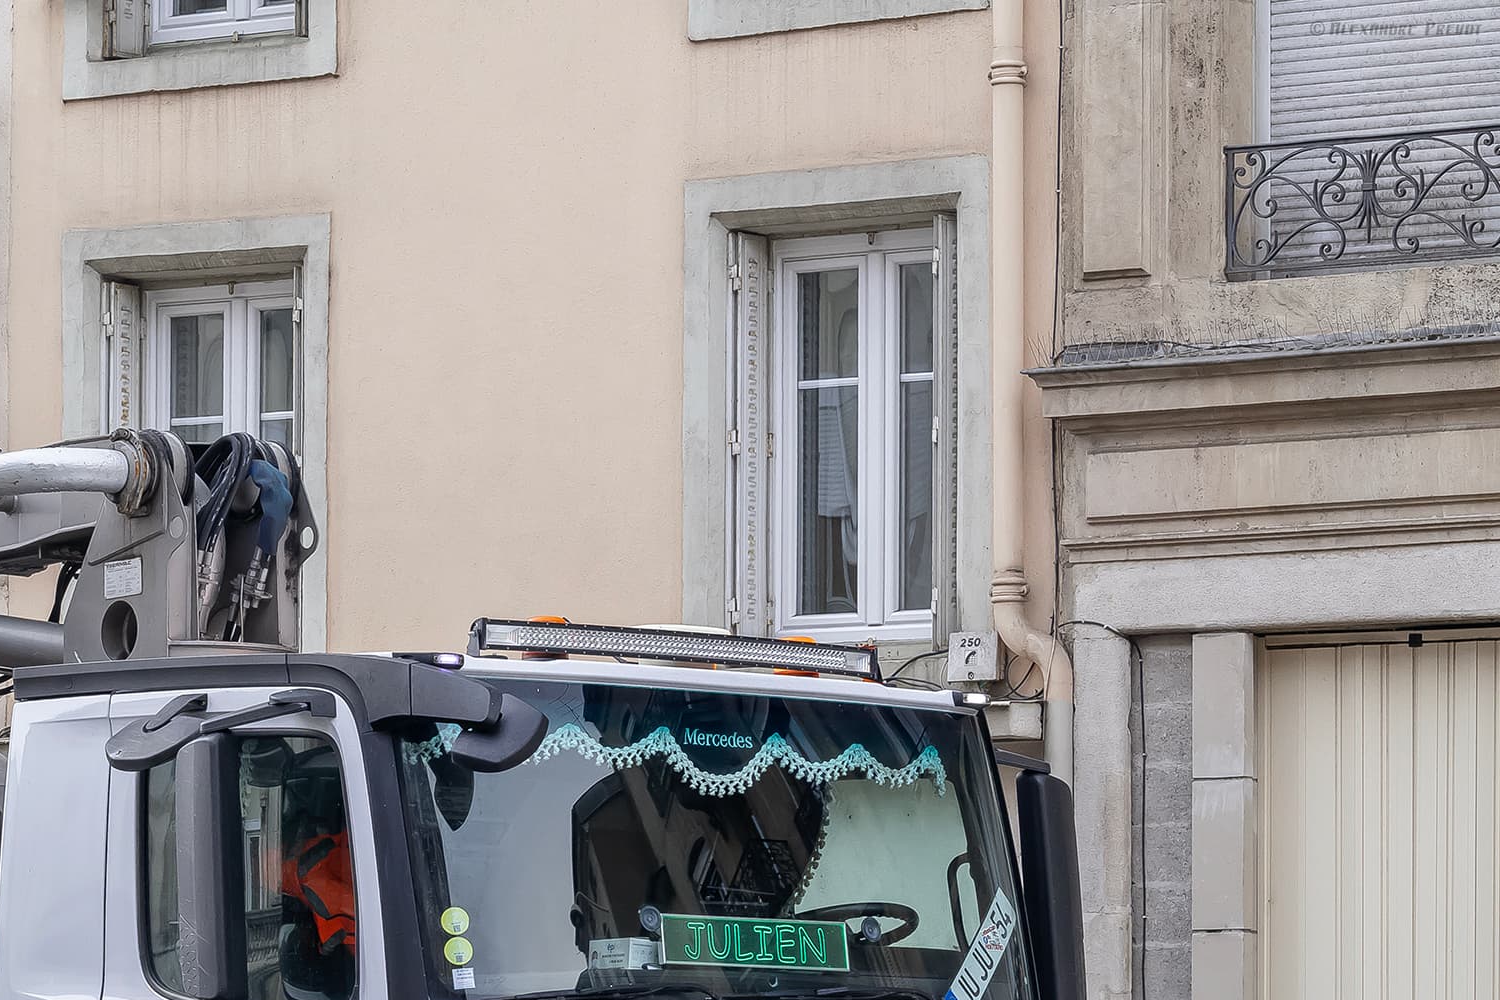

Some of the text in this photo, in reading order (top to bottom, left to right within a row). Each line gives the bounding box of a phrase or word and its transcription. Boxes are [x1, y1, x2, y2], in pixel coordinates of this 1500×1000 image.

[960, 637, 981, 648] 250
[683, 727, 754, 749] Mercedes
[684, 921, 827, 964] JULIEN
